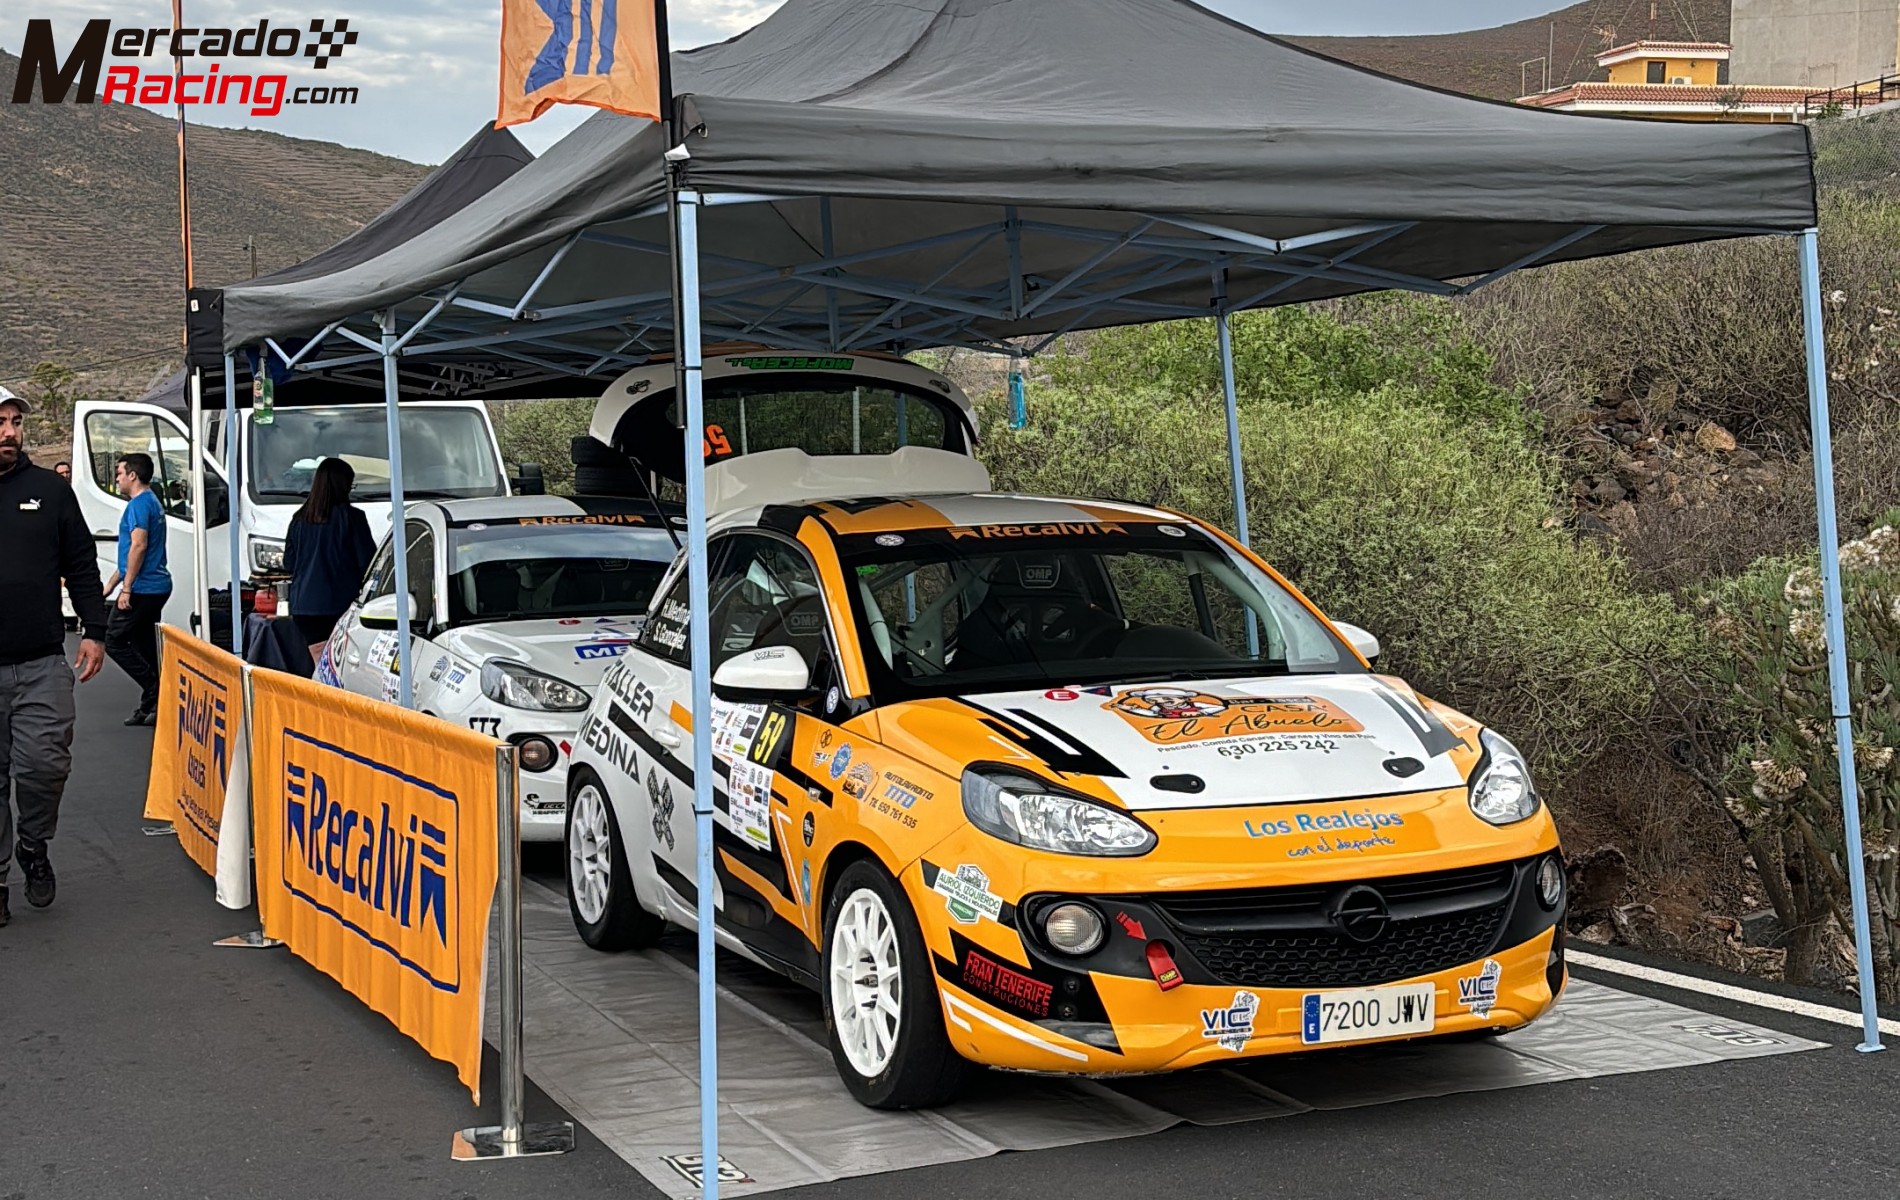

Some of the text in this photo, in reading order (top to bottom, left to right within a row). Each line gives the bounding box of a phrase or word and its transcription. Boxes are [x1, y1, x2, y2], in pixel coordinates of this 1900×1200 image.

[542, 515, 623, 526] Recalvi
[982, 523, 1097, 538] Recalvi
[1026, 568, 1052, 579] OMP
[790, 614, 820, 627] OMP
[1241, 704, 1325, 712] CASA
[754, 711, 786, 764] 59
[1144, 712, 1349, 741] El Abuelo
[1202, 738, 1238, 747] Comida
[1239, 735, 1275, 744] Canaria
[1218, 740, 1340, 757] 630 225 242
[878, 802, 891, 814] 650
[890, 808, 903, 821] 761
[902, 815, 918, 829] 535
[1244, 809, 1404, 837] Los Realejos
[308, 772, 417, 928] Recalvi
[1287, 833, 1396, 857] con el deporte
[938, 872, 962, 891] AURIOL
[963, 884, 1000, 910] IZQUIERDO
[965, 952, 1053, 1006] FRAN TENERIFE
[1460, 975, 1495, 996] VIC
[963, 971, 1049, 1017] CONSTRUCIONES
[1202, 1007, 1251, 1030] VIC
[1322, 993, 1429, 1032] 7200 JWV
[1308, 1023, 1316, 1034] E
